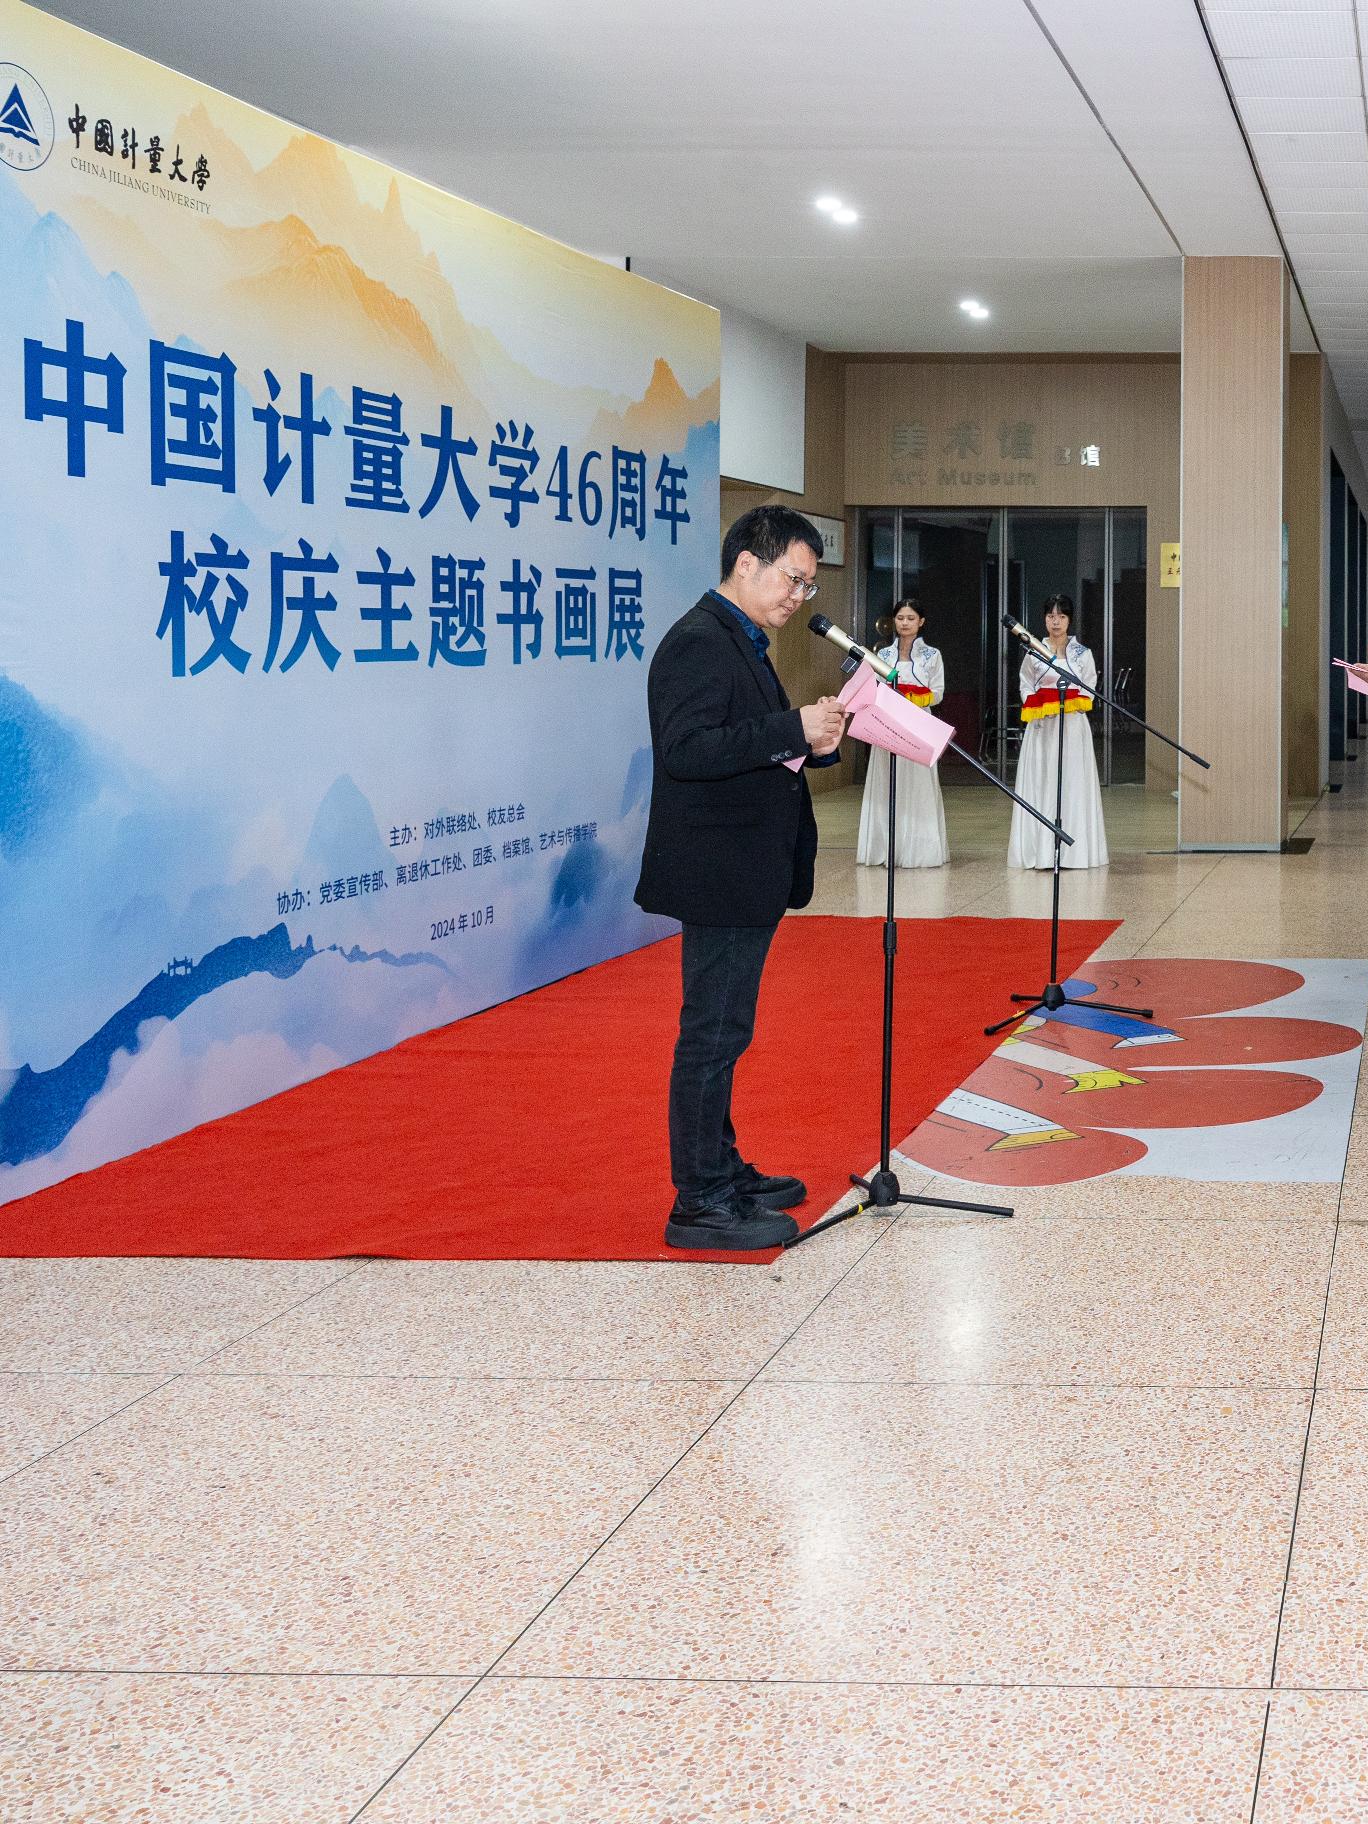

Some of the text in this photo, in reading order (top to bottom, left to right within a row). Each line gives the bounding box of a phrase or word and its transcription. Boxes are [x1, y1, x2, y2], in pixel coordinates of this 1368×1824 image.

[70, 157, 211, 215] CHINA JILIANG UNIVERSITY
[23, 318, 691, 546] 中国计量大学46周年
[937, 467, 1037, 486] Museum
[156, 530, 645, 678] 校庆主题书画展
